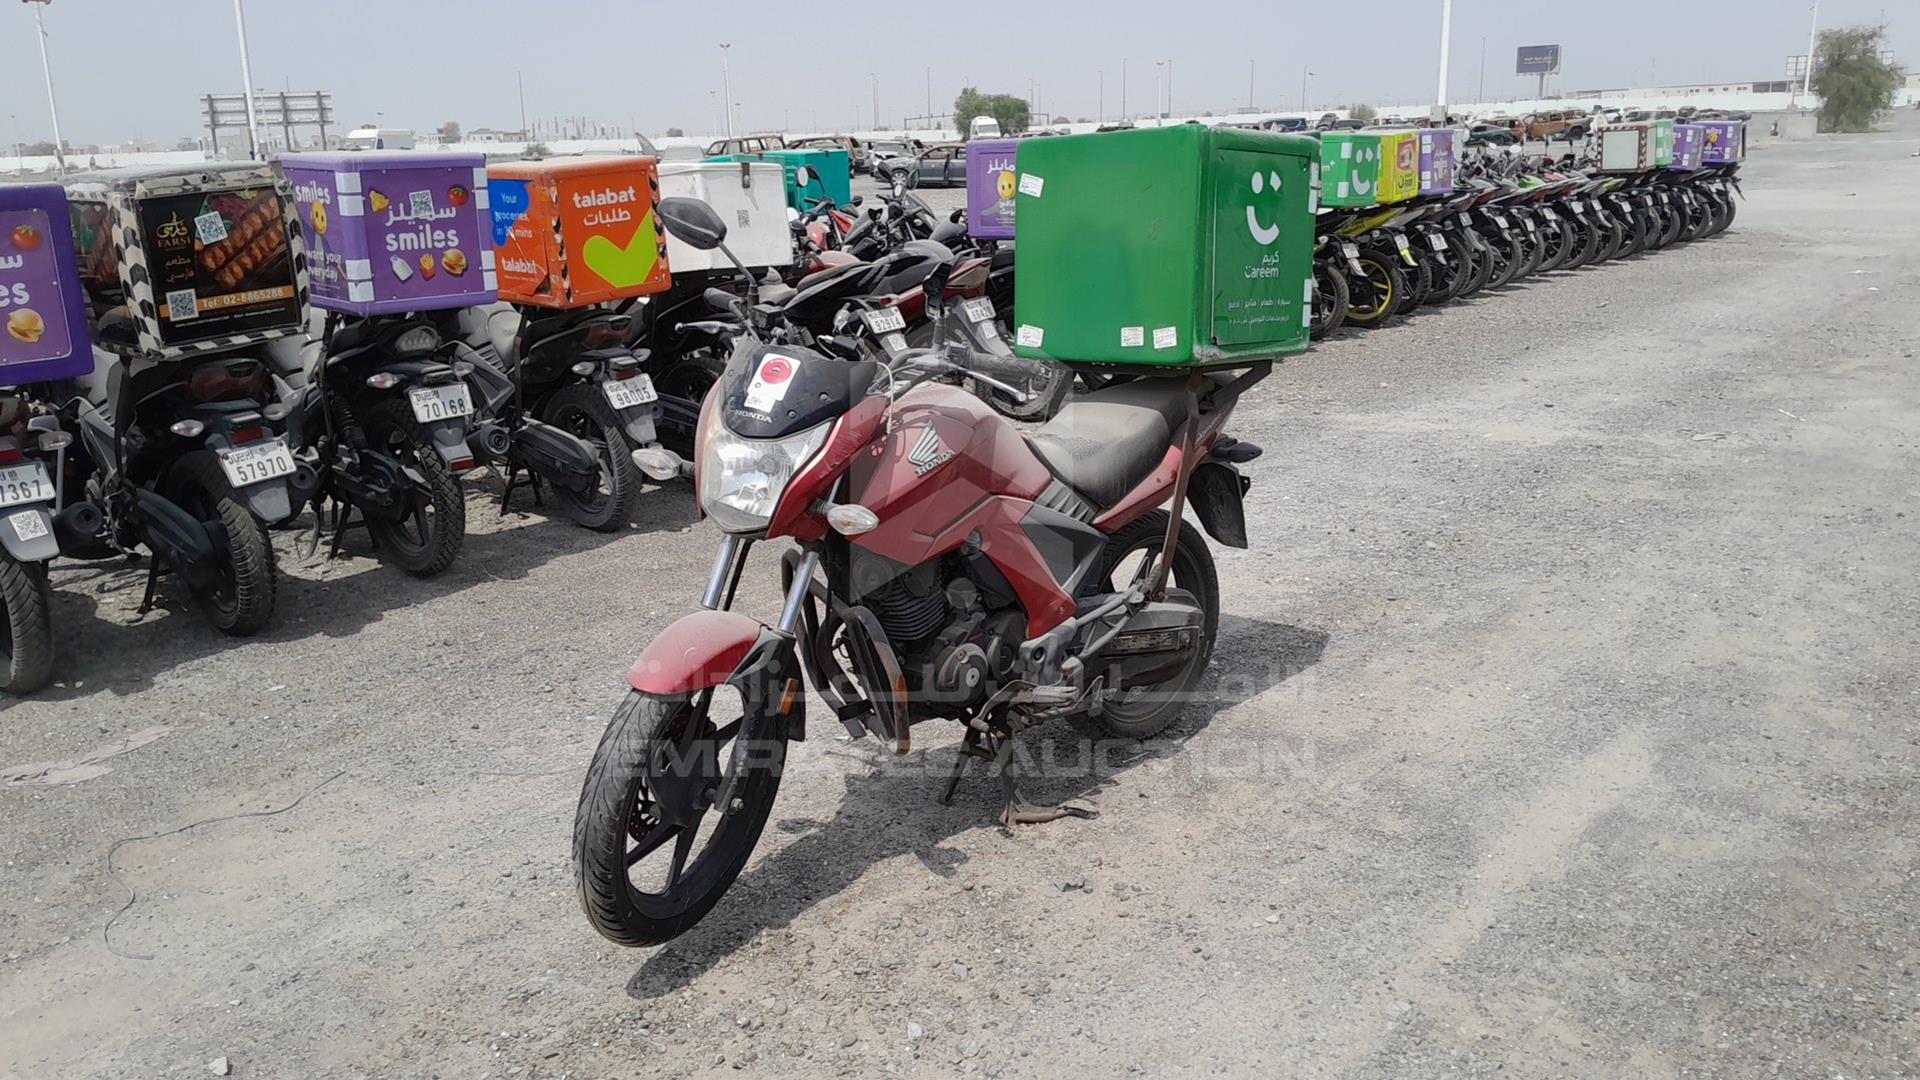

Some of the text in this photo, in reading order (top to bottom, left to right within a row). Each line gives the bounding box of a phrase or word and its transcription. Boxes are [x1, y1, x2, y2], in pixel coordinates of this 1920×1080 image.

[295, 180, 331, 205] smiles
[501, 192, 518, 204] Your
[572, 186, 637, 208] talabat
[583, 208, 631, 228] طلبات
[385, 224, 459, 252] smiles
[502, 257, 538, 275] talabat
[1262, 250, 1280, 266] كريم
[617, 387, 651, 405] 98005
[423, 398, 466, 420] 70168
[734, 410, 774, 424] HONDA
[236, 456, 287, 482] 57970
[915, 449, 956, 476] HONDA
